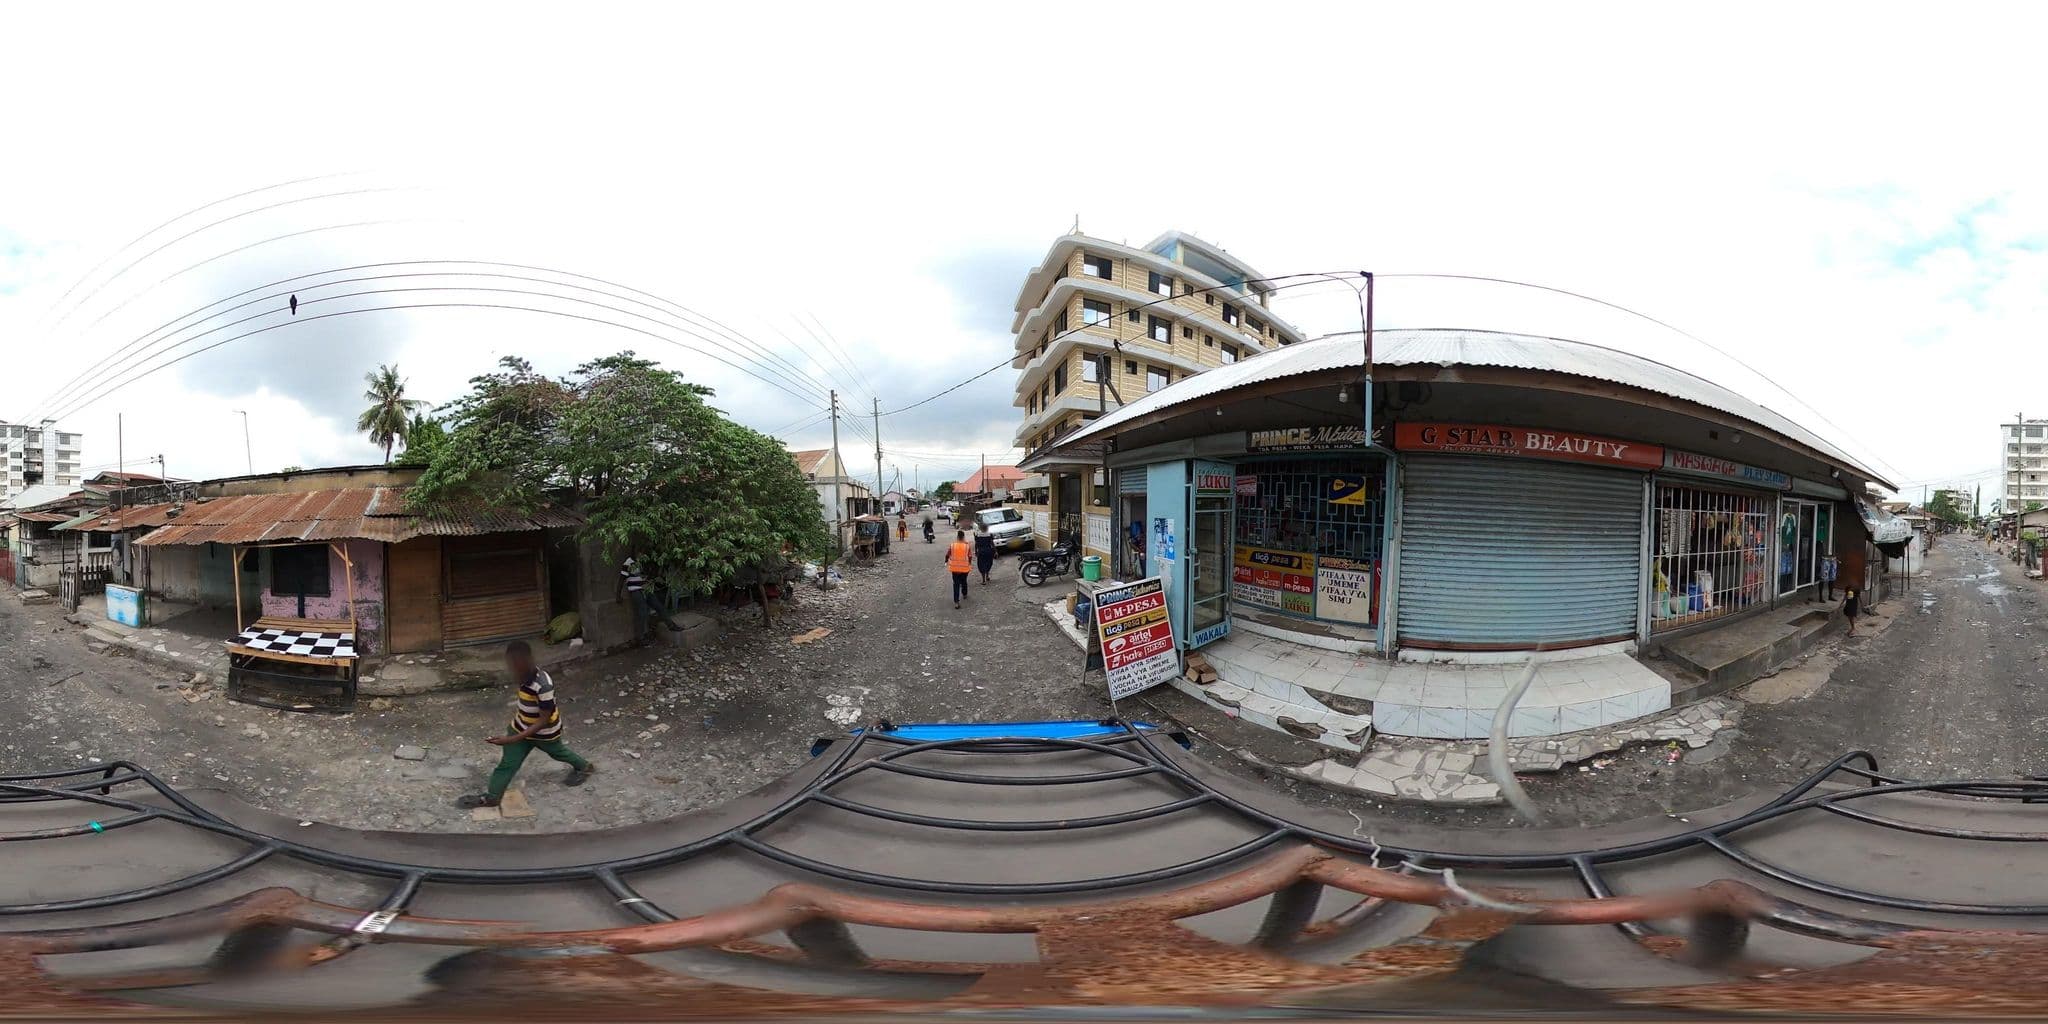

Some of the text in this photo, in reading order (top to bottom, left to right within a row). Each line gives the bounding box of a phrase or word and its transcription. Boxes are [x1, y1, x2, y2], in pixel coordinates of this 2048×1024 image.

[1251, 425, 1385, 448] PRINCE Mbilini
[1421, 427, 1629, 459] G STAR BEAUTY
[1198, 475, 1232, 488] LUKU
[1328, 579, 1360, 590] UMEME
[1349, 573, 1366, 583] VYA
[1099, 587, 1132, 606] PRINCE
[1328, 595, 1352, 604] SIMU
[1350, 589, 1367, 599] VYA
[1113, 597, 1159, 619] M-PESA
[1129, 628, 1152, 643] airtel
[1195, 624, 1228, 645] WAKALA
[1130, 662, 1144, 670] VYA
[1146, 655, 1162, 664] SIMU
[1133, 667, 1148, 676] VYA
[1137, 674, 1147, 682] NA
[1146, 675, 1162, 686] SIMU
